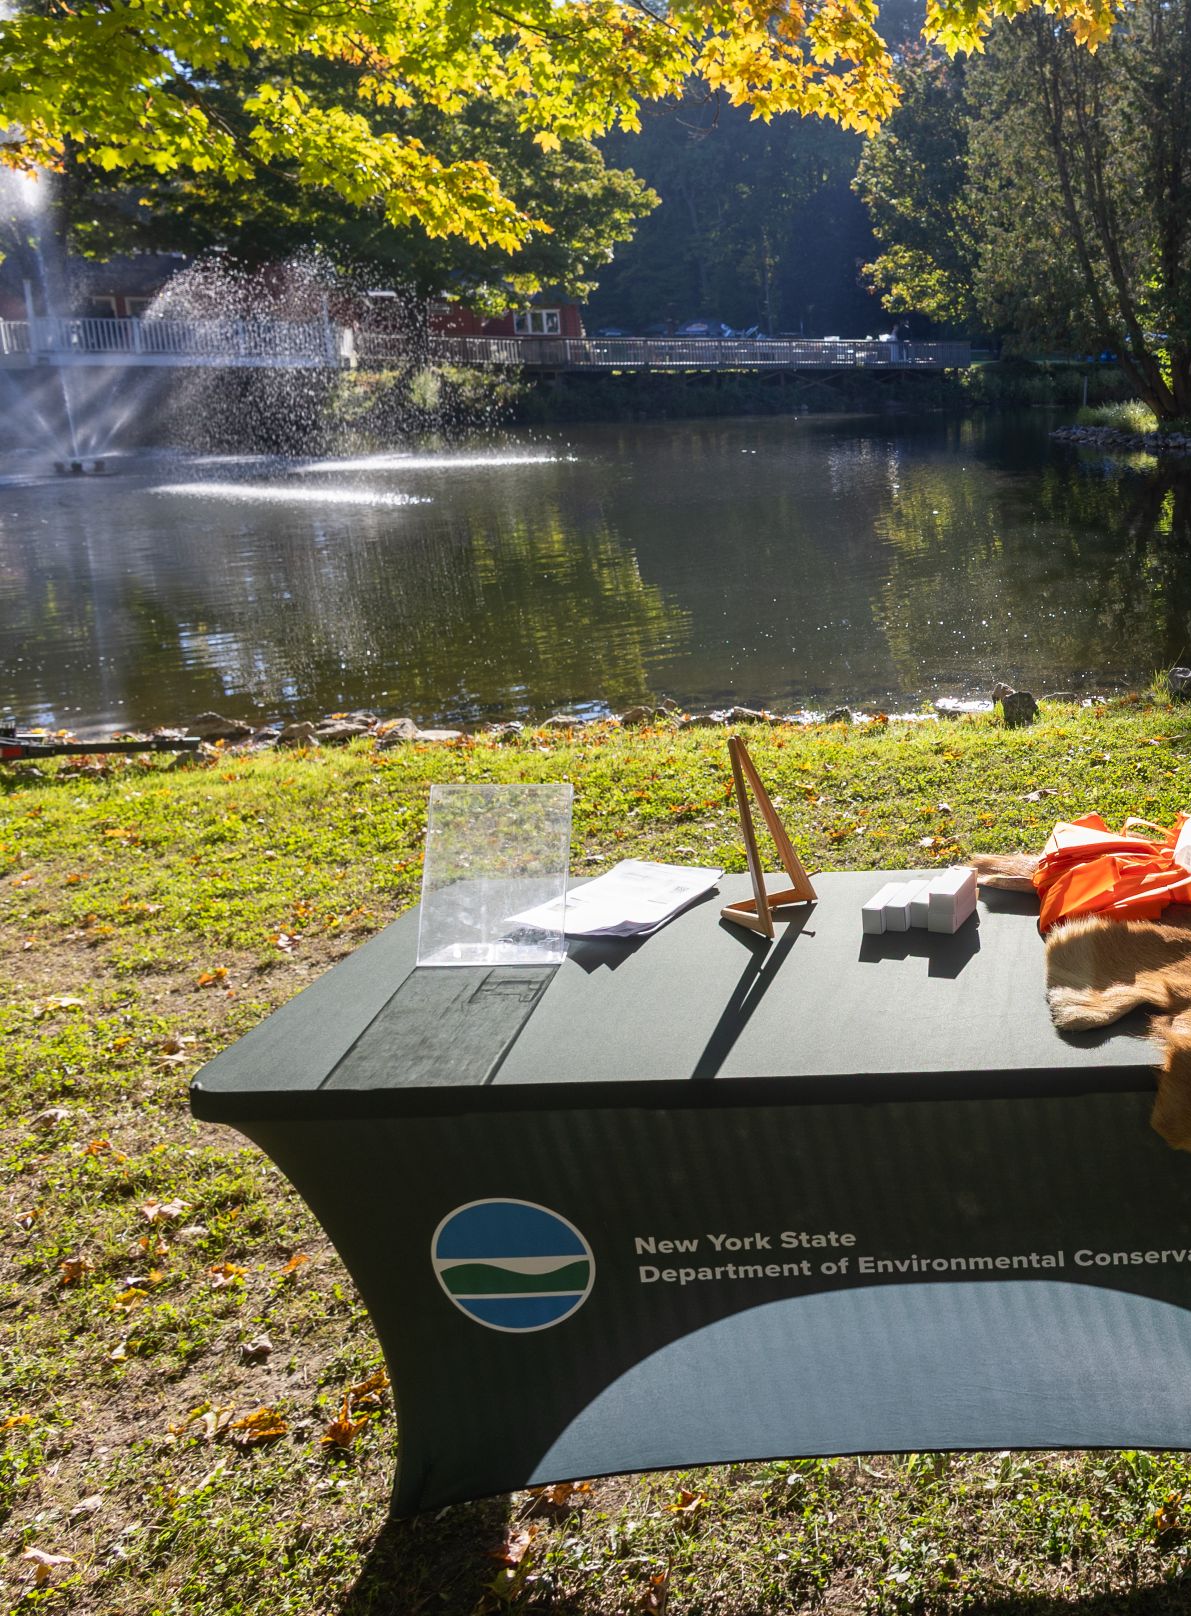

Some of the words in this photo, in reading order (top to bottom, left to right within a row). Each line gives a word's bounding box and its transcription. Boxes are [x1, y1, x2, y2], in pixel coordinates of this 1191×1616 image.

[634, 1236, 698, 1256] New
[707, 1233, 772, 1252] York
[780, 1230, 856, 1250] State
[639, 1259, 812, 1286] Department
[820, 1257, 850, 1276] of
[858, 1250, 1066, 1274] Environmental
